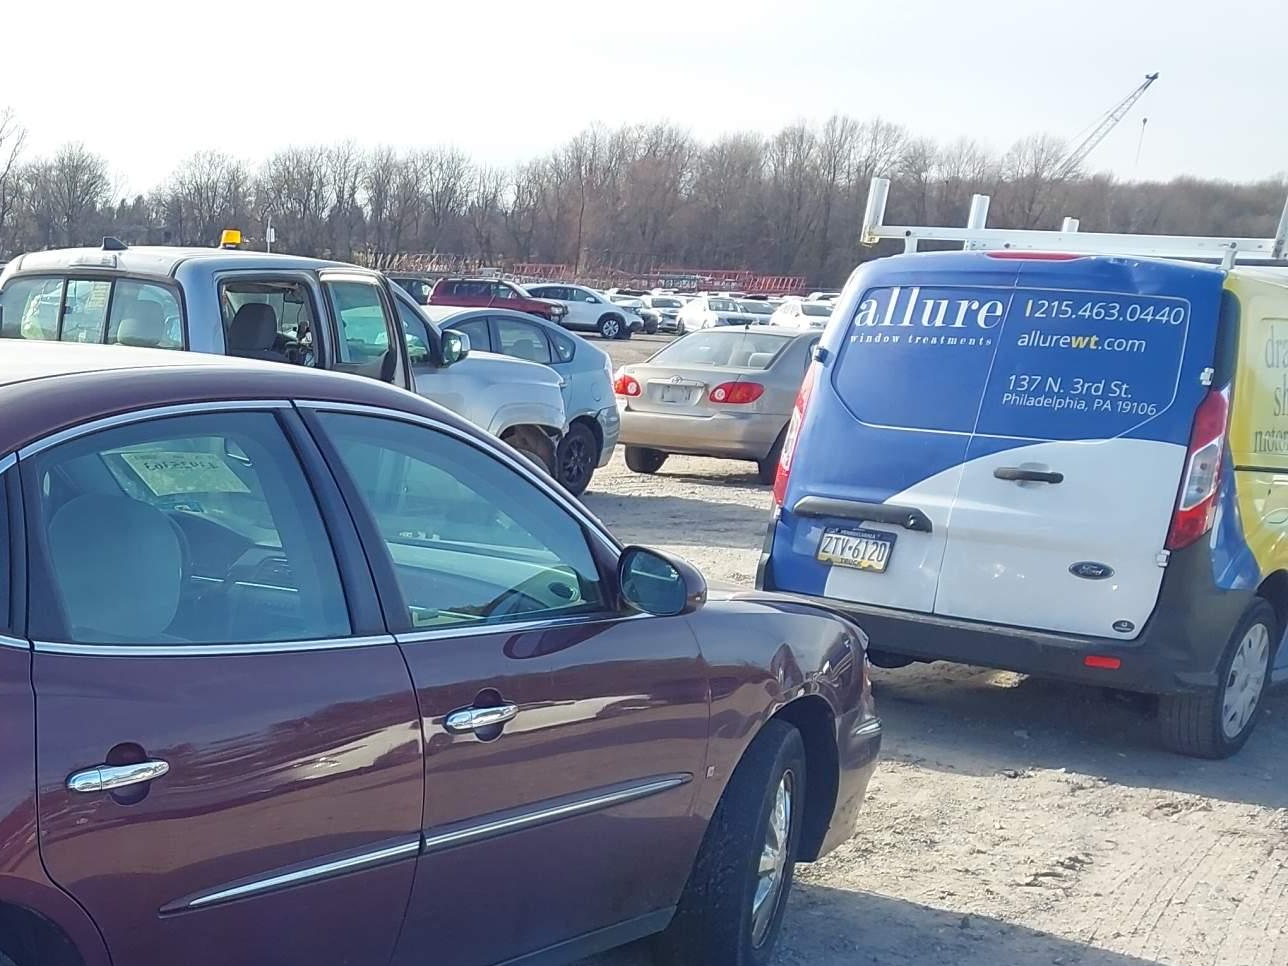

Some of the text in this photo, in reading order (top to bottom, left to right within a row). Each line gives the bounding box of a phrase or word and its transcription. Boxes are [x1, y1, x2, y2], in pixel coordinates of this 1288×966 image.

[854, 286, 1004, 329] allure
[850, 332, 993, 346] window treatments
[1017, 330, 1146, 353] allurewt.com
[1008, 374, 1132, 398] 137 N. 3rd St.
[1002, 392, 1157, 416] Philadelphia, PA 19106
